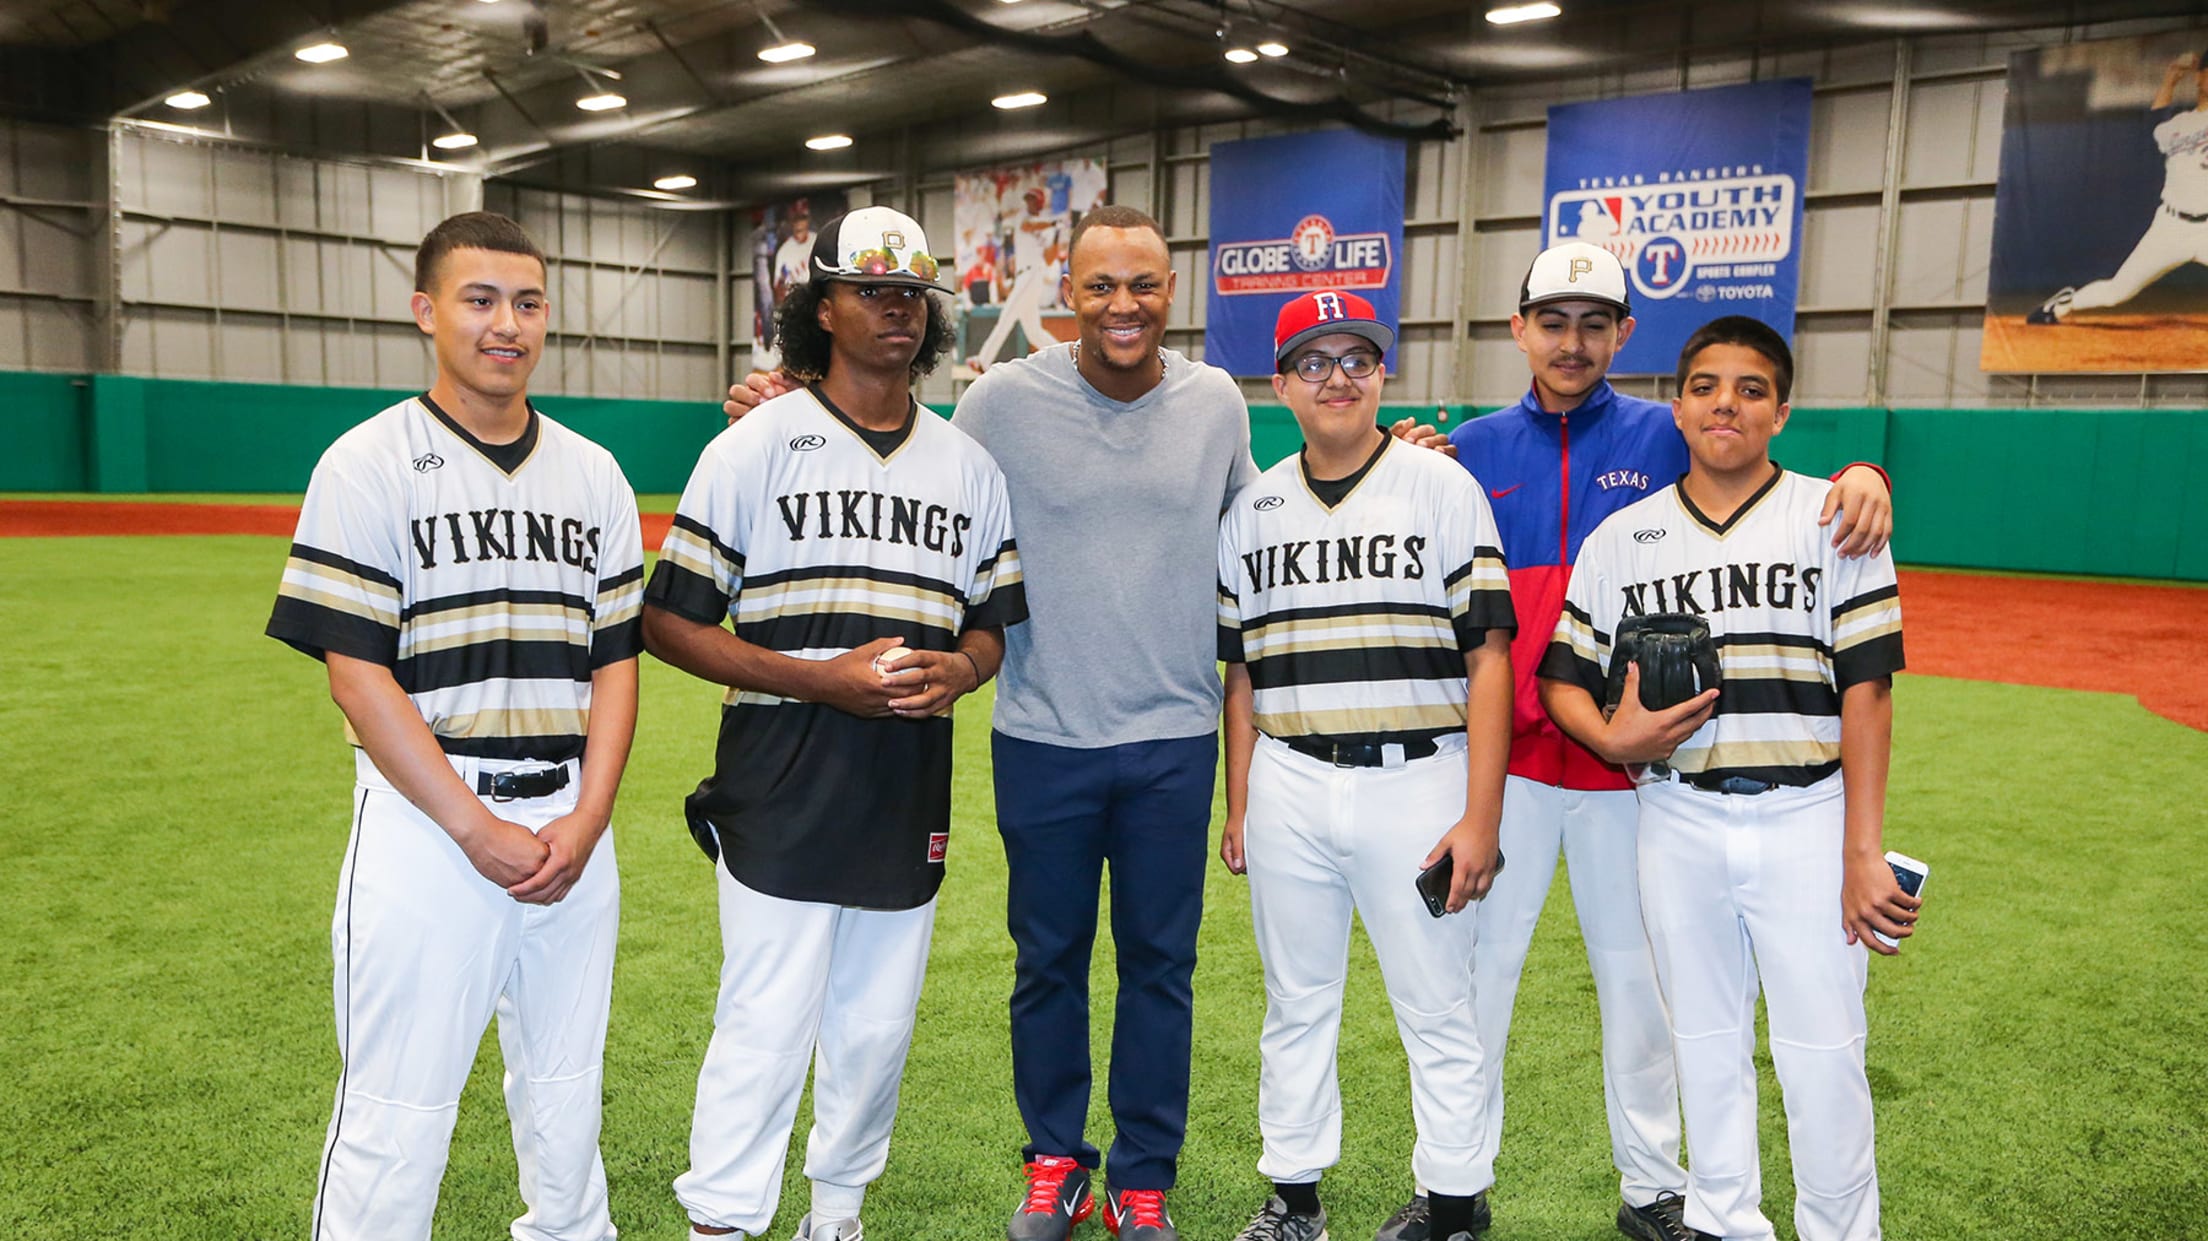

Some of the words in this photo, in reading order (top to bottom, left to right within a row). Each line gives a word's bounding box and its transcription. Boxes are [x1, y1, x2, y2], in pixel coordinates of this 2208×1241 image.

[1579, 174, 1644, 189] TEXAS
[1659, 164, 1763, 183] RANGERS
[1629, 184, 1783, 212] YOUTH
[1627, 206, 1781, 236] ACADEMY
[1221, 245, 1291, 275] GLOBE
[1334, 239, 1380, 269] LIFE
[1305, 233, 1321, 255] T
[1568, 256, 1593, 283] P
[1646, 244, 1678, 284] T
[1302, 271, 1368, 287] CENTER
[1717, 284, 1774, 300] TOYOTA
[1596, 470, 1650, 491] TEXAS
[776, 489, 972, 558] VIKINGS
[411, 507, 601, 576] VIKINGS
[1241, 534, 1427, 595] VIKINGS
[1621, 562, 1823, 619] VIKINGS
